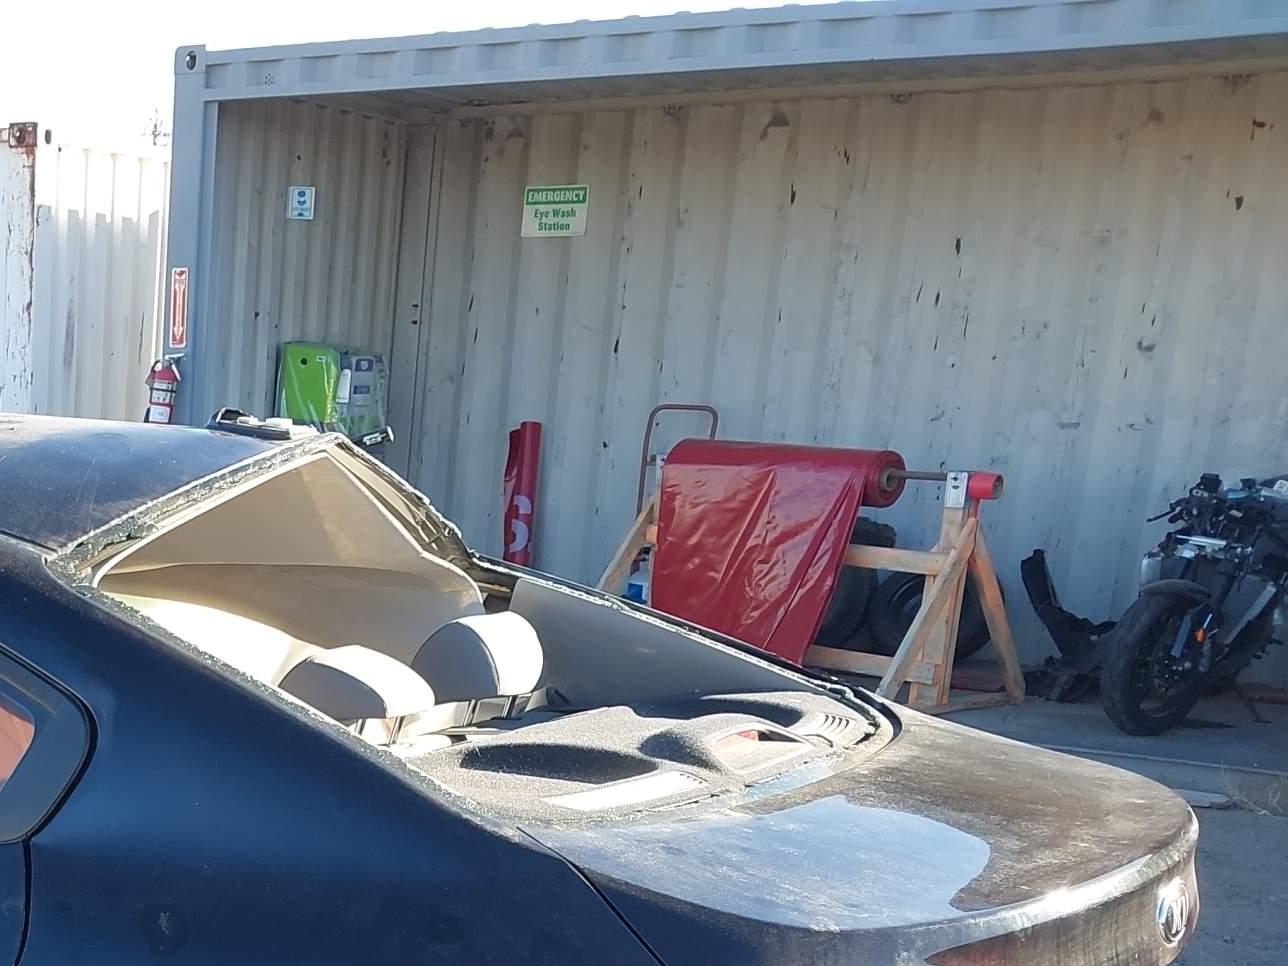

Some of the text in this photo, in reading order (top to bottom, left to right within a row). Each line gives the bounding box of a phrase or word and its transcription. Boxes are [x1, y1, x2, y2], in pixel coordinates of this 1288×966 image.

[528, 190, 585, 203] EMERGENCY
[534, 207, 577, 221] Eye Wash
[537, 221, 571, 232] Station
